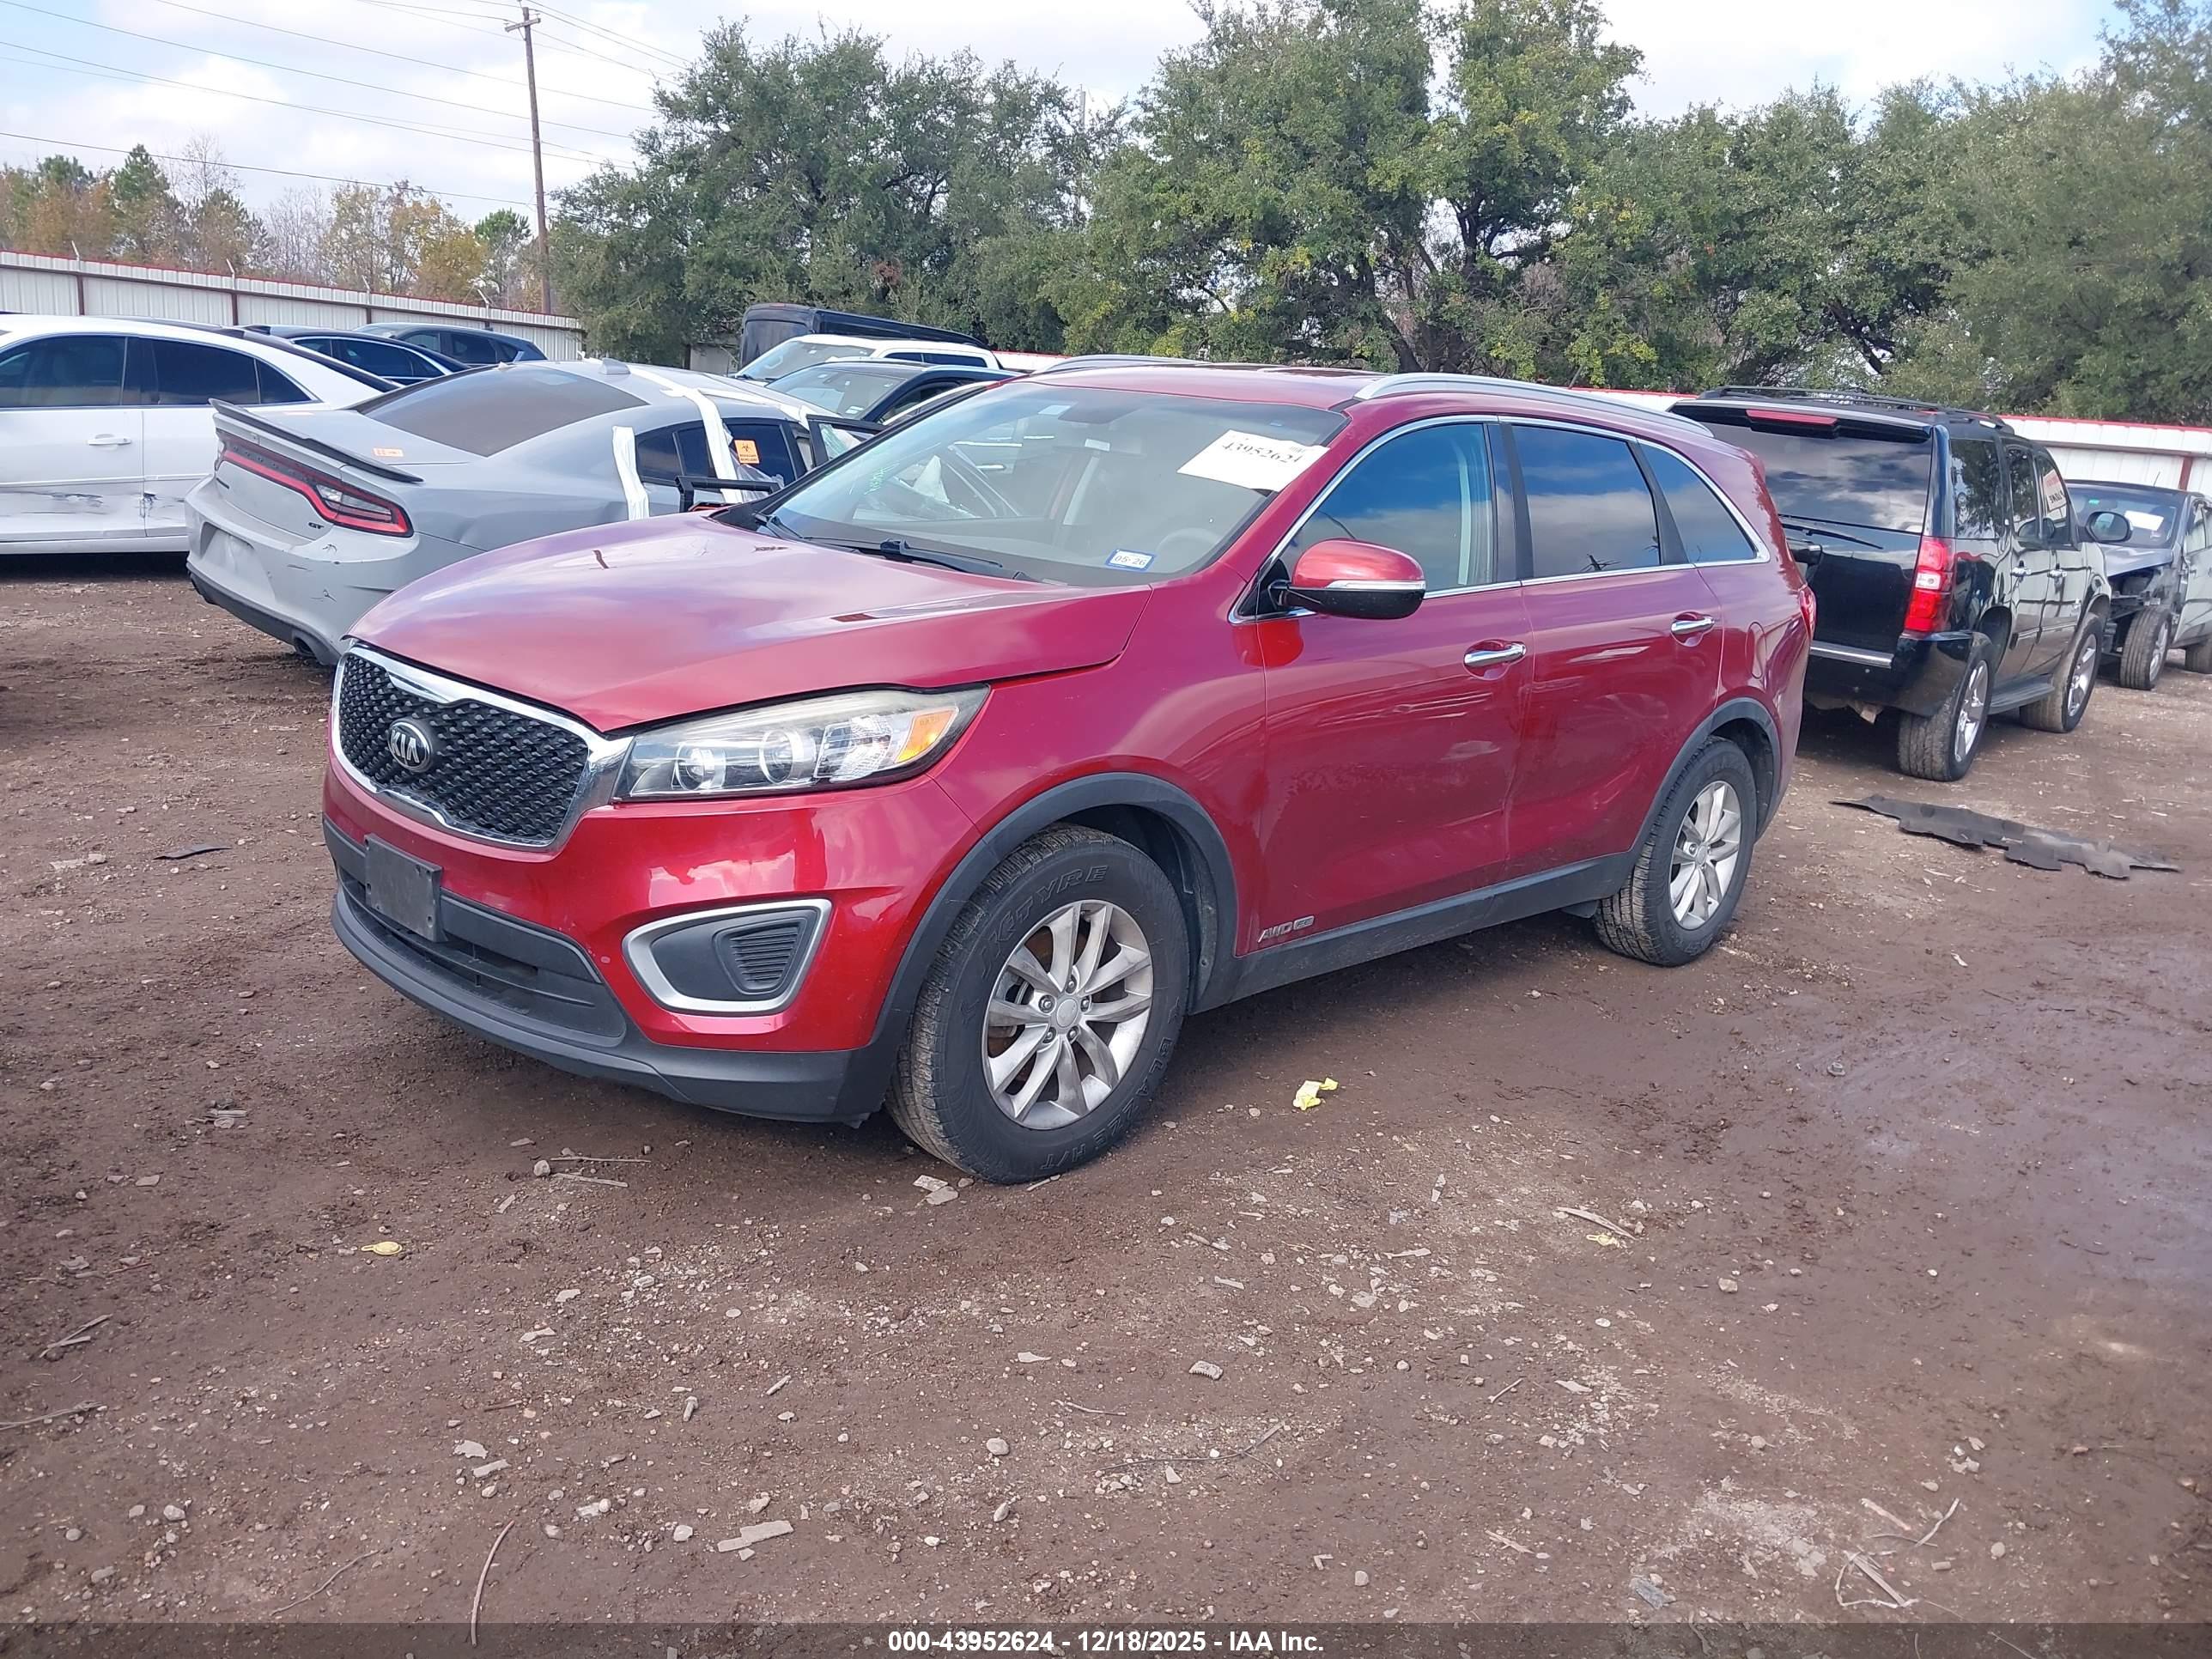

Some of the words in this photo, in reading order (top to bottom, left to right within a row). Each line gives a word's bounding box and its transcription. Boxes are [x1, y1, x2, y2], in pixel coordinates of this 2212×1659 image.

[391, 728, 421, 764] KIA
[1015, 865, 1109, 921] TYRE
[1256, 921, 1293, 944] AWD
[1040, 1142, 1087, 1170] H/T
